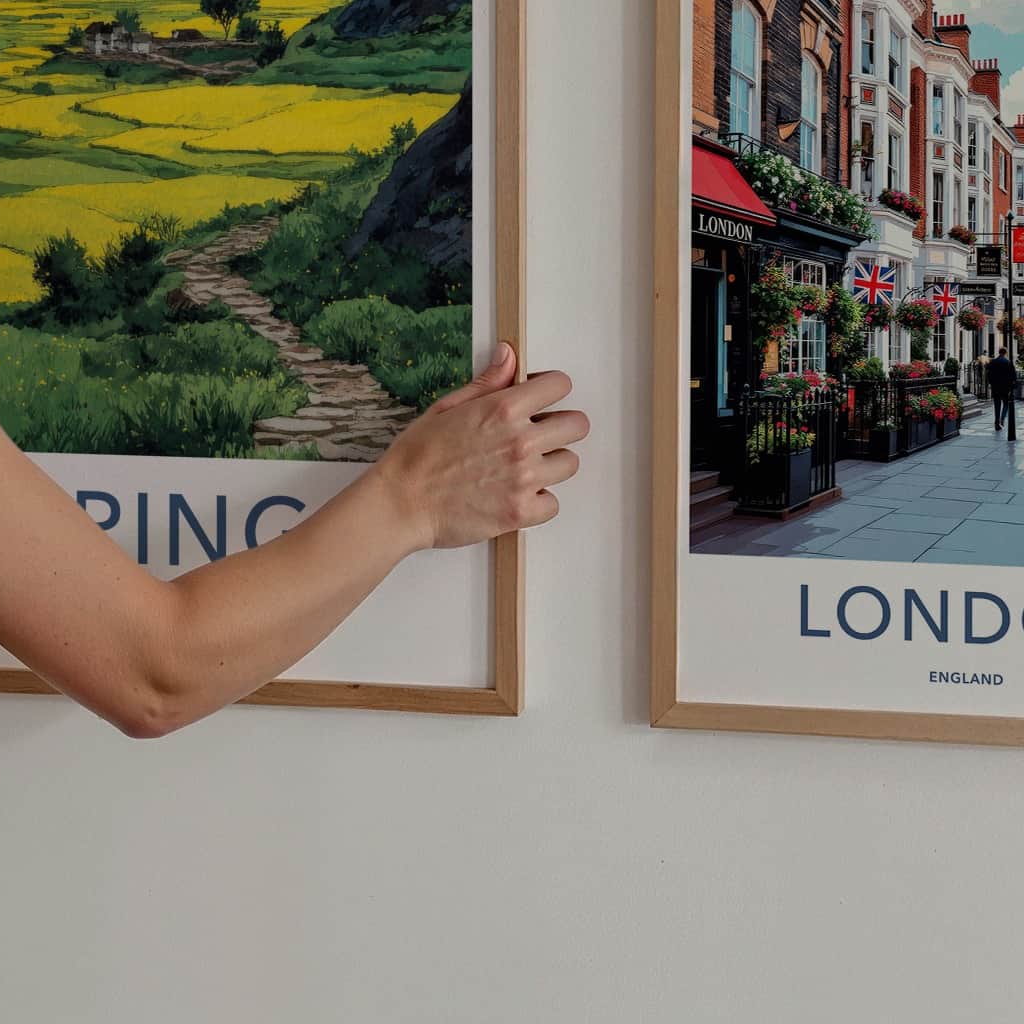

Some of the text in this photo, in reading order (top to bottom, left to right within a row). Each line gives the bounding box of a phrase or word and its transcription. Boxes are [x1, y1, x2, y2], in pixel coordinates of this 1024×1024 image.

[698, 213, 753, 242] LONDON
[800, 584, 1024, 645] LOND
[929, 671, 1004, 686] ENGLAND
